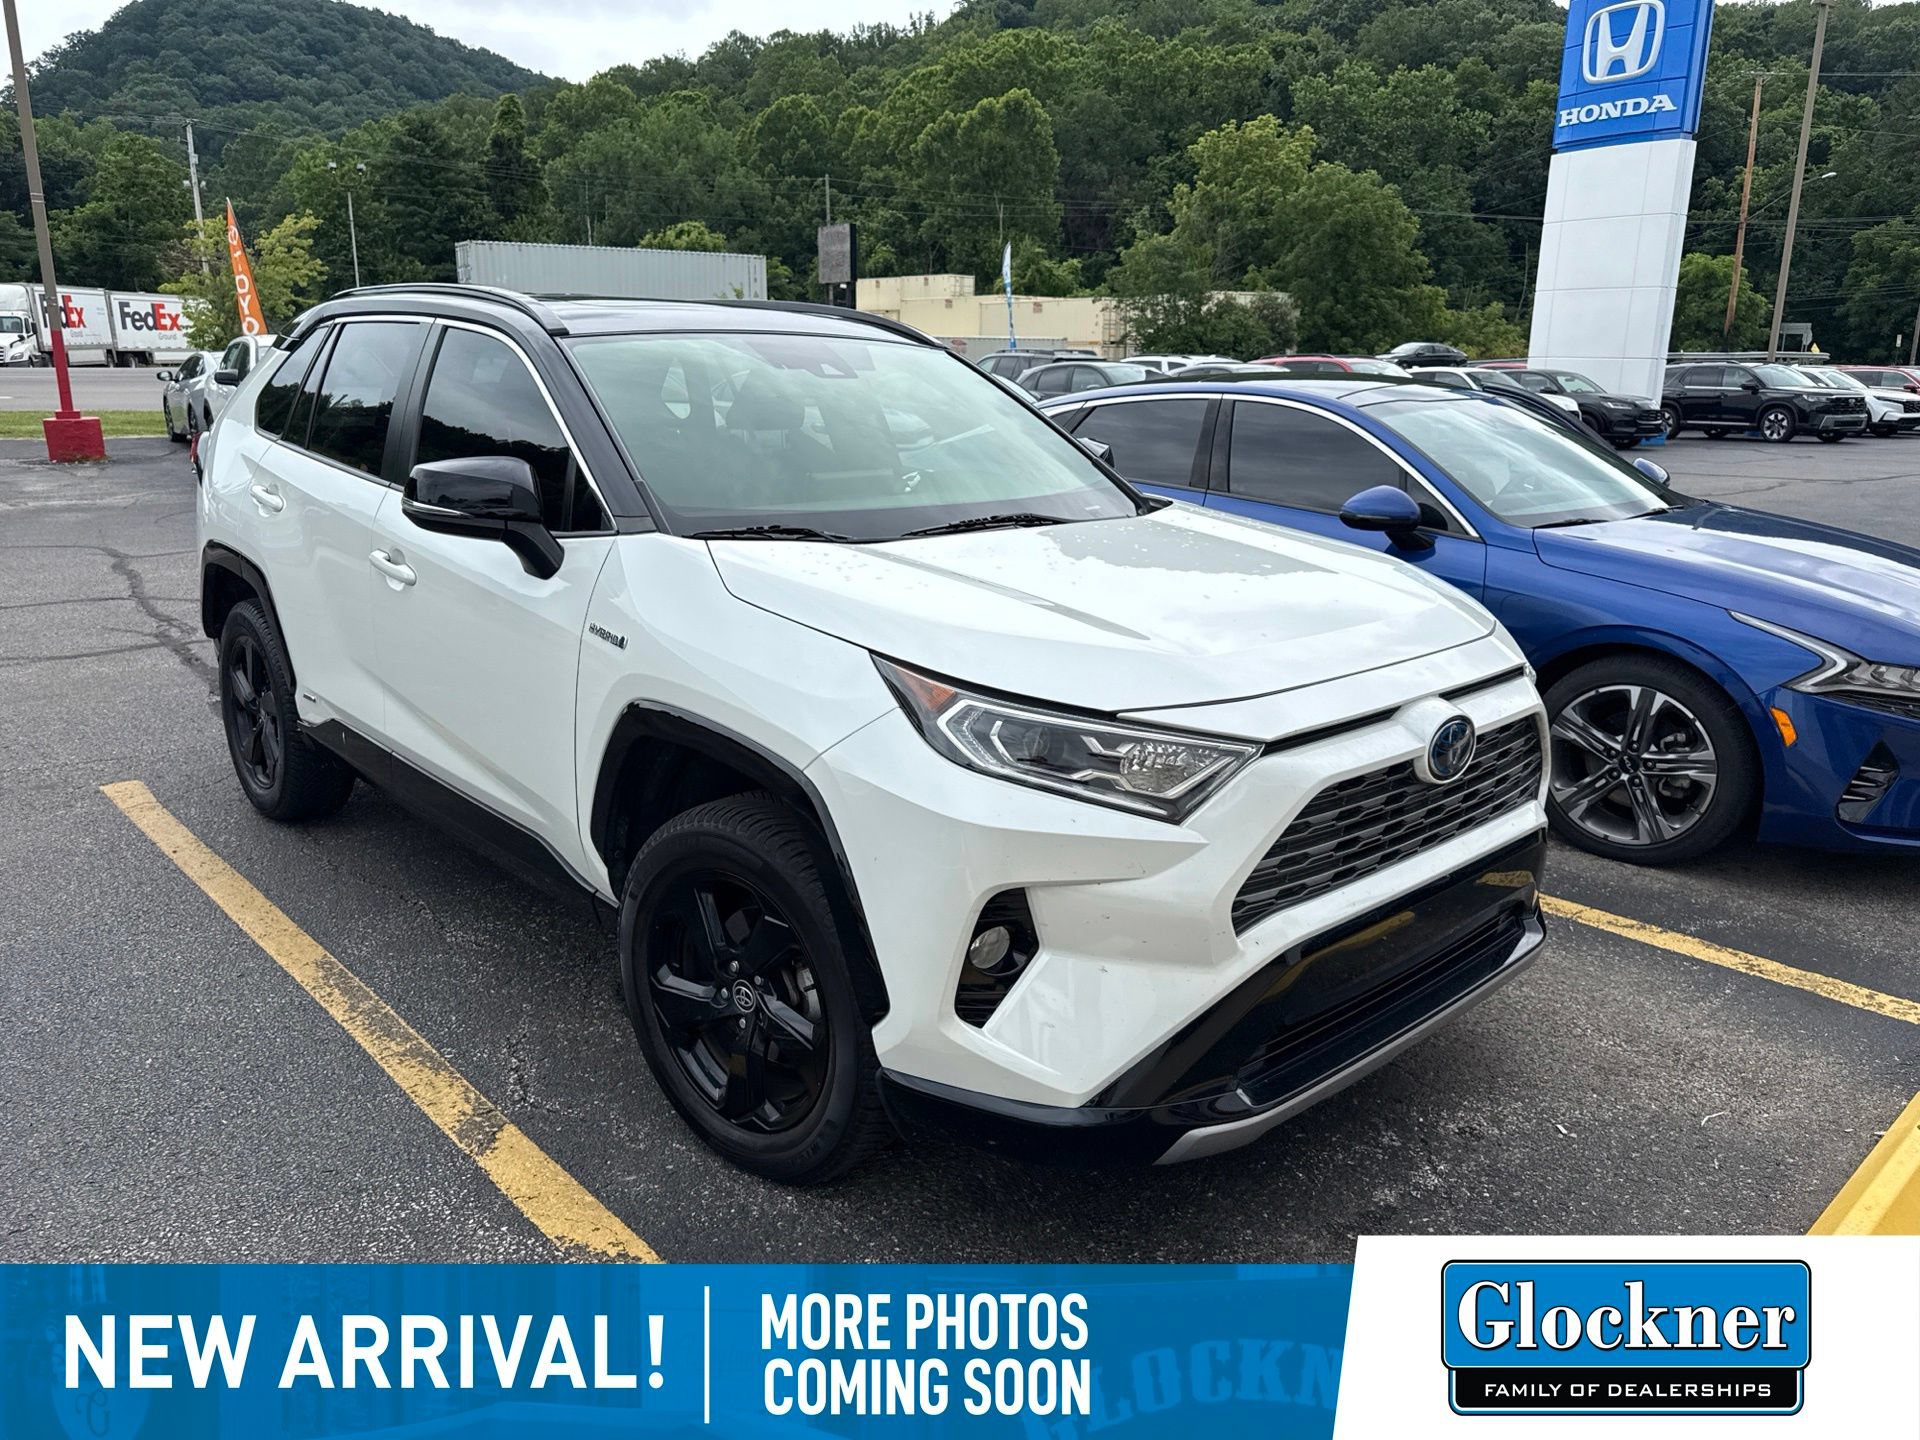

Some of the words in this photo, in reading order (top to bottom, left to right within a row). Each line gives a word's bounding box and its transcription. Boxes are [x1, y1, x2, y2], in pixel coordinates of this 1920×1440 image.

[1558, 94, 1677, 127] HONDA
[39, 293, 87, 329] FdEx
[118, 301, 182, 331] FedEx
